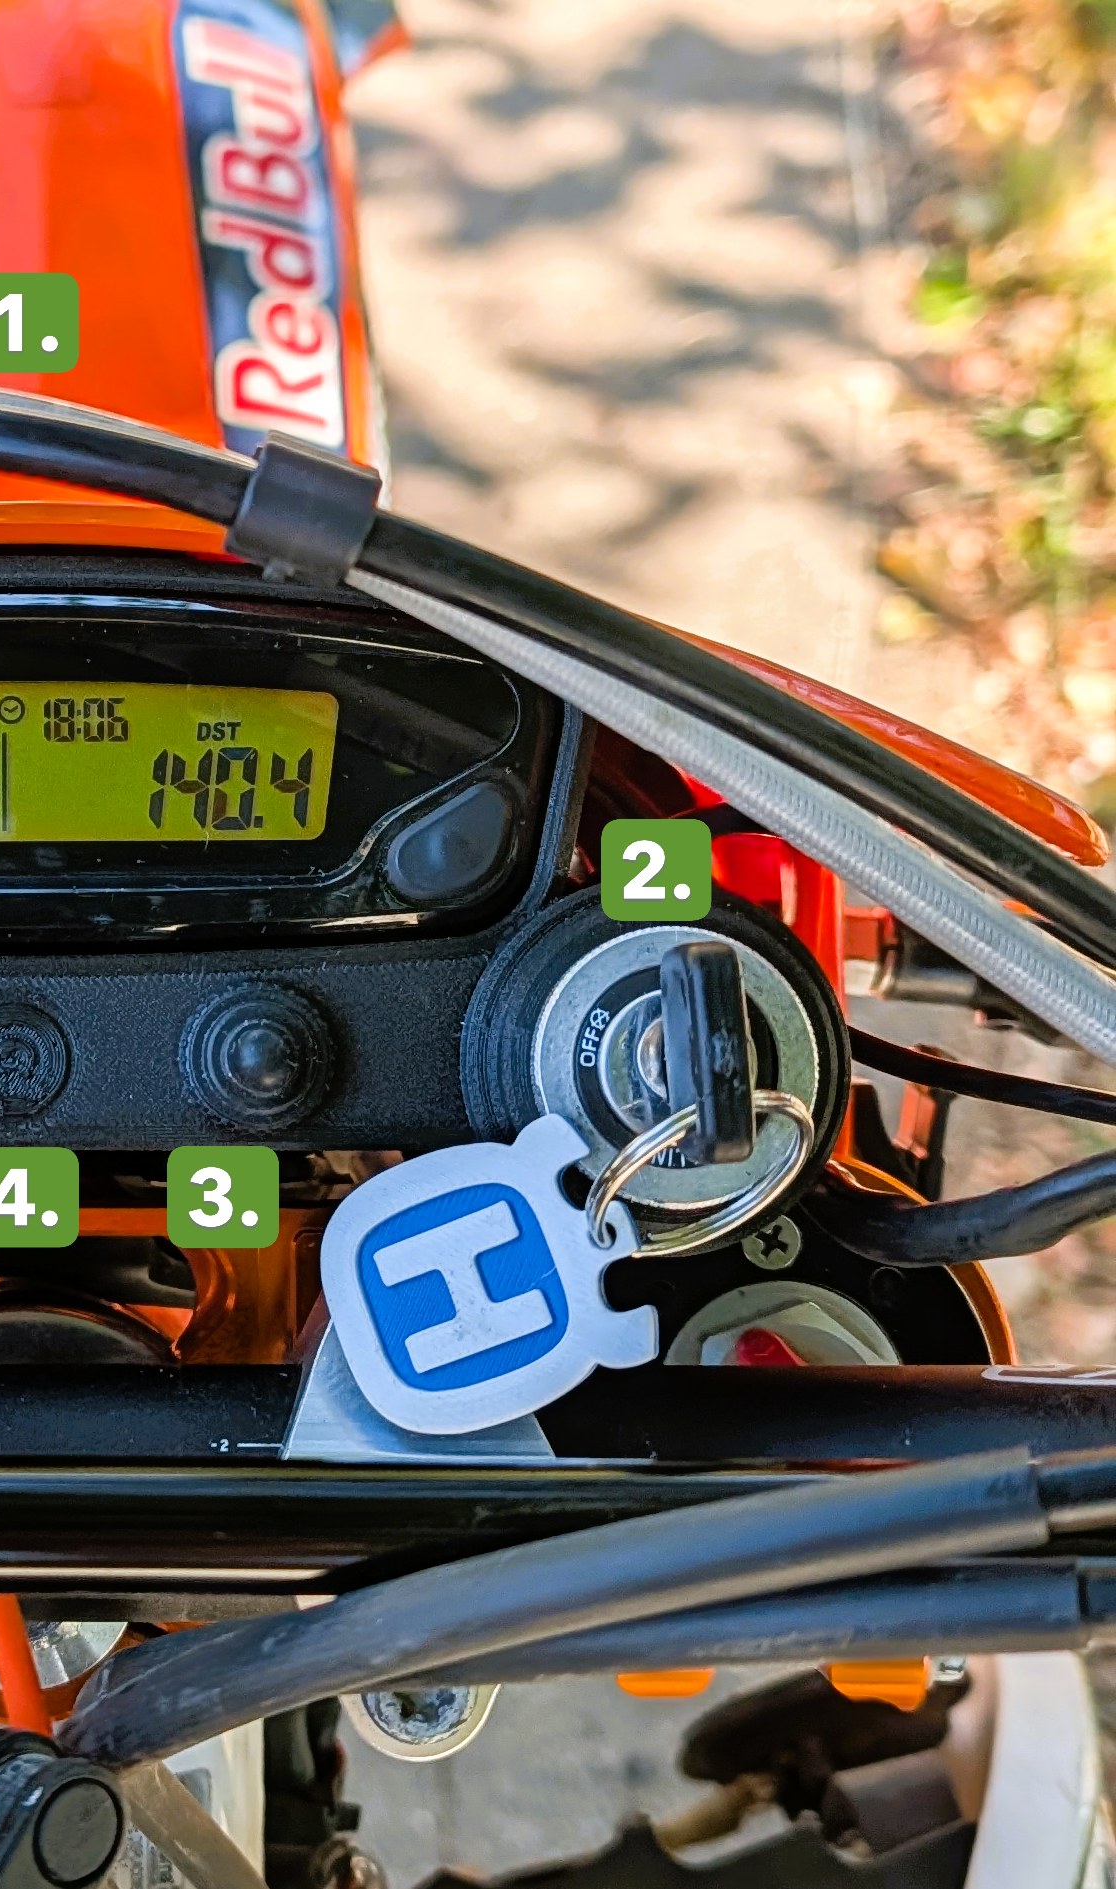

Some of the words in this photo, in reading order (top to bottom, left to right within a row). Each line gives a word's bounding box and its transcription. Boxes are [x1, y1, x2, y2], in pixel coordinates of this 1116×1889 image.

[43, 697, 129, 742] 18:06
[197, 721, 241, 744] DST
[148, 746, 313, 829] 140.4
[580, 1027, 599, 1067] OFF
